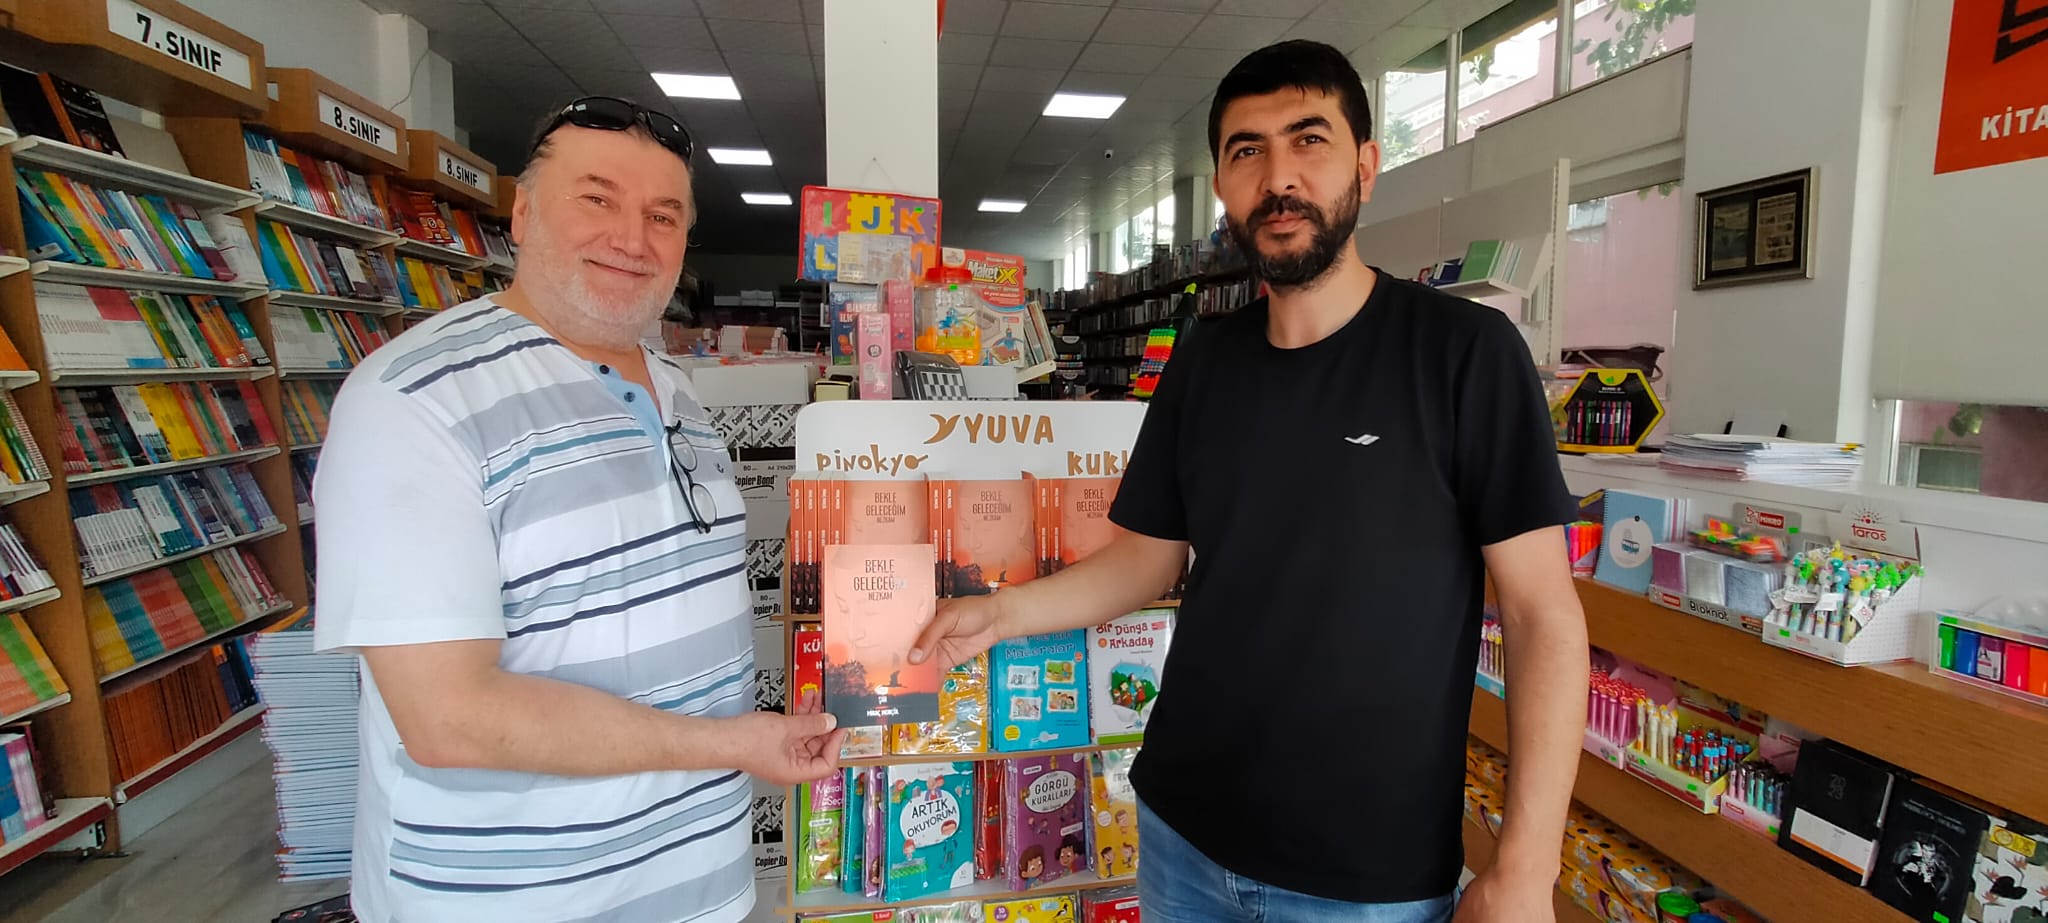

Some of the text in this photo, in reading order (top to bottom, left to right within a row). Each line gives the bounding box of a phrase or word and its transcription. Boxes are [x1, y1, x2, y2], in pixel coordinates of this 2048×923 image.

[136, 12, 222, 72] 7. SINIF
[334, 106, 381, 144] 8. SINIF
[1981, 104, 2048, 141] KİTA
[446, 158, 478, 186] 8. SINIF
[861, 206, 880, 230] J
[900, 207, 924, 234] K
[815, 244, 836, 270] L
[964, 412, 1054, 445] YUVA
[757, 474, 775, 485] Bond
[874, 492, 897, 503] BEKLE
[1083, 488, 1105, 500] BEKLE
[1851, 523, 1887, 541] taros
[865, 559, 895, 574] BEKLE
[853, 574, 905, 591] GELECEĞ
[752, 604, 773, 616] opier
[803, 638, 822, 654] KÜ
[1031, 788, 1072, 806] KURALLARI
[911, 798, 949, 819] ARTIK
[907, 806, 957, 838] OKUYORUM
[755, 856, 778, 868] Copier
